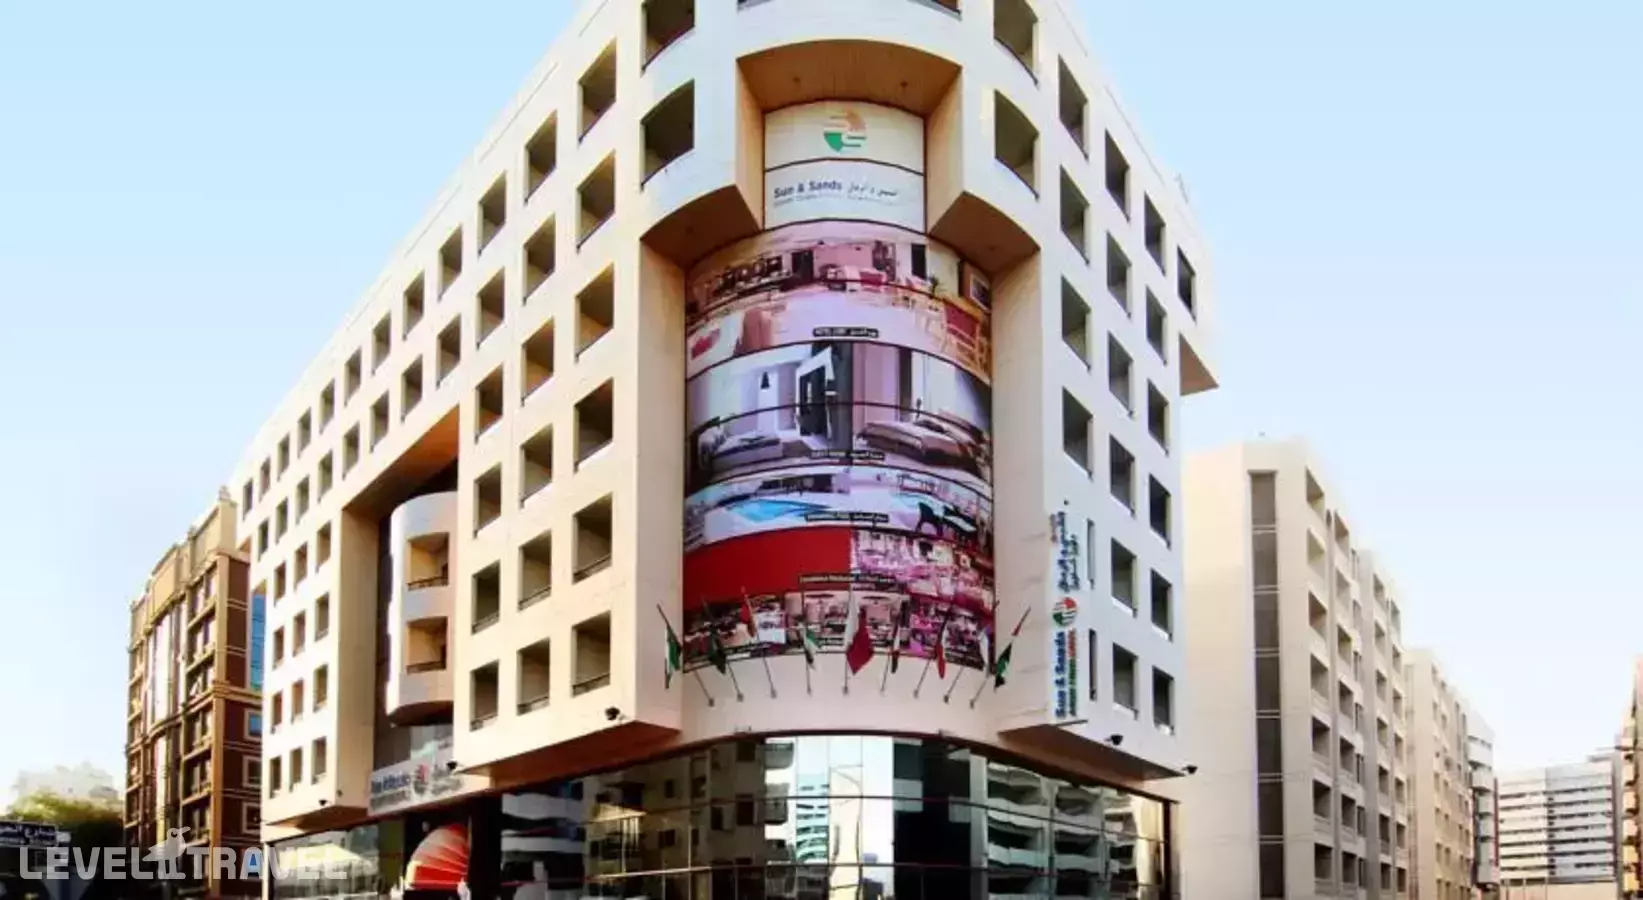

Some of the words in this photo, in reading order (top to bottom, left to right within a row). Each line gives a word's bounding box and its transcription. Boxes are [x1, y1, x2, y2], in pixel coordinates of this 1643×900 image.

[774, 187, 794, 198] Sun
[798, 183, 804, 193] &
[809, 180, 842, 191] Sands
[1055, 631, 1067, 675] Sands
[1055, 677, 1065, 688] &
[1055, 689, 1066, 718] Sun
